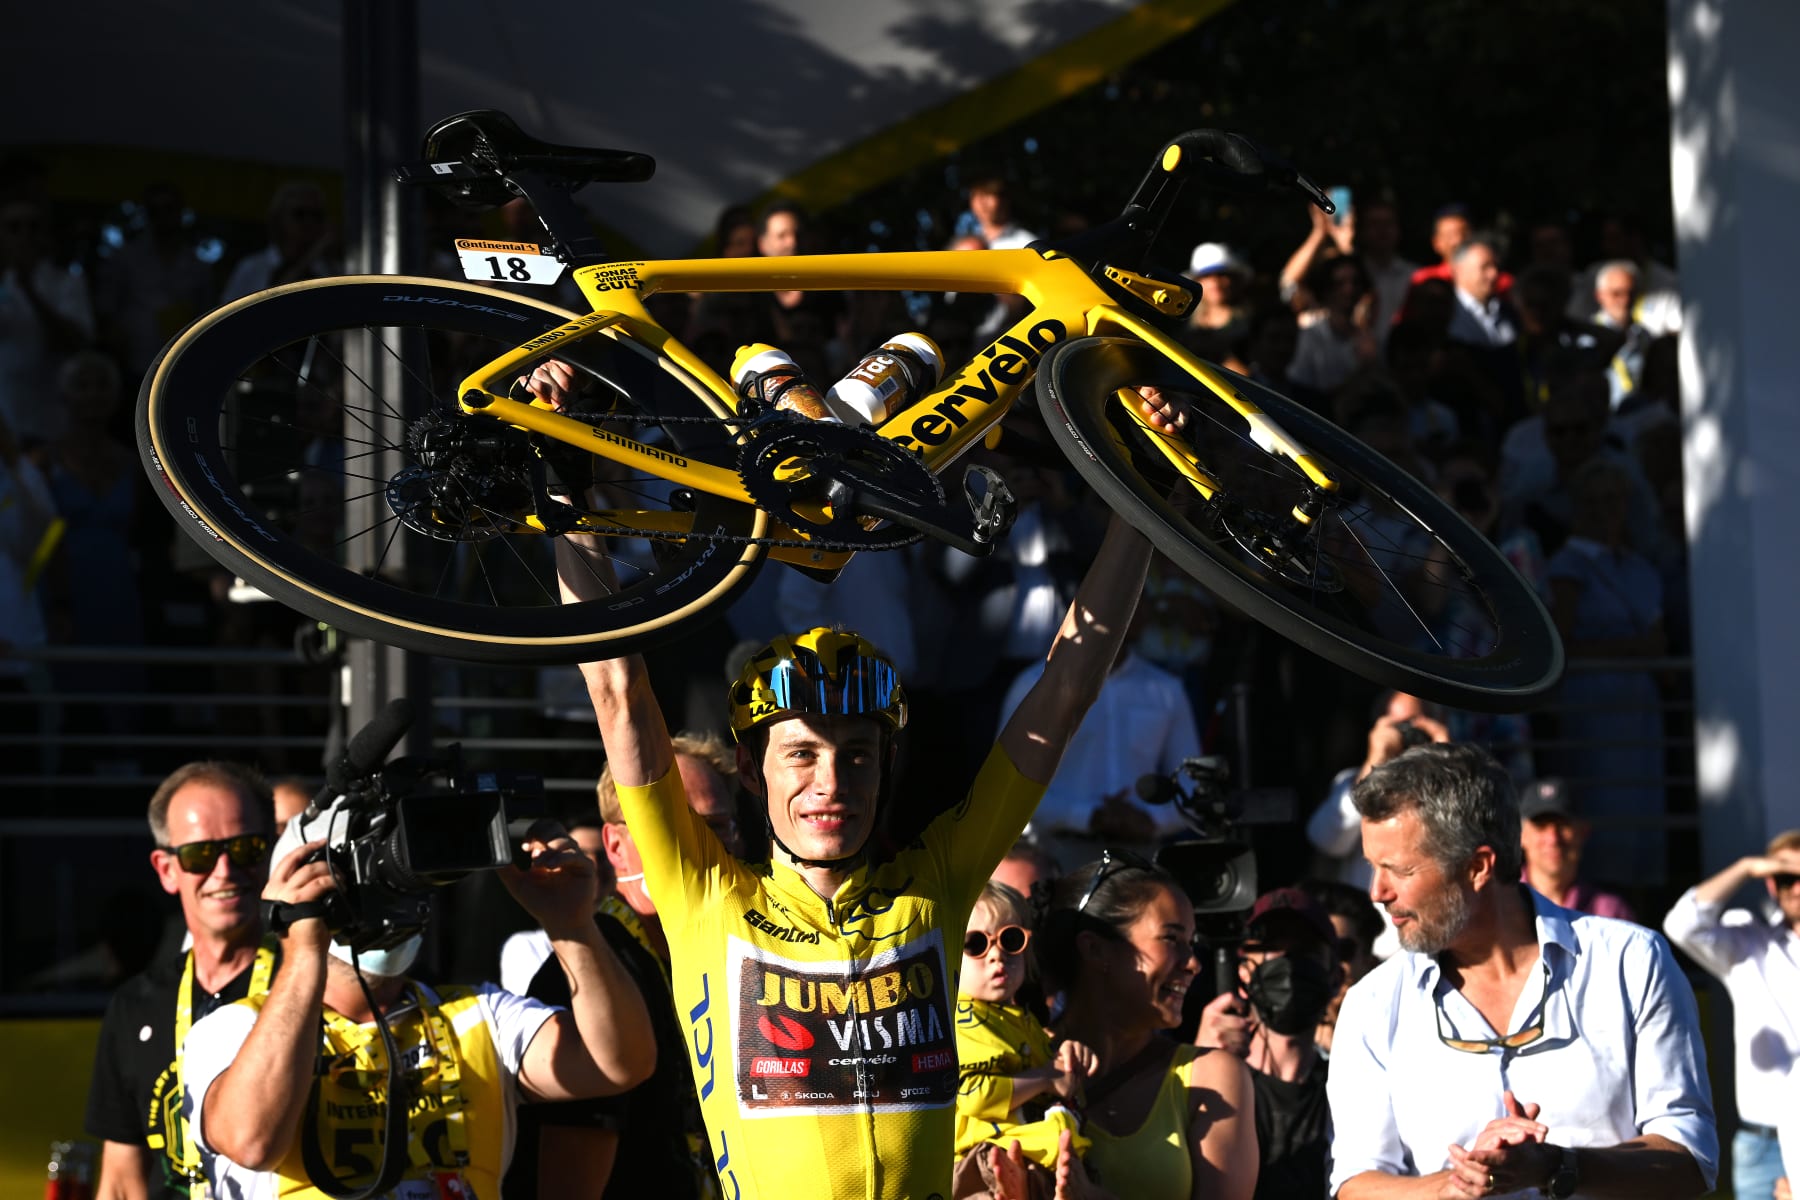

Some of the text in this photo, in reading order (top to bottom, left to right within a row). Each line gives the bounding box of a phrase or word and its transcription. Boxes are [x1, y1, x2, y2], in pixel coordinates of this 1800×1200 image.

[457, 239, 526, 251] Continental
[485, 257, 531, 282] 18
[594, 268, 637, 279] JONAS
[597, 275, 638, 283] VINDER
[596, 280, 644, 292] GULT
[521, 331, 566, 352] JUMBO
[852, 356, 895, 380] Tac
[592, 428, 688, 468] SHIMANO
[757, 961, 934, 1014] JUMBO
[690, 973, 715, 1102] LCL
[827, 1004, 944, 1052] VISMA
[756, 1060, 805, 1074] GORILLAS
[917, 1051, 951, 1070] HEMA
[717, 1130, 741, 1200] LC
